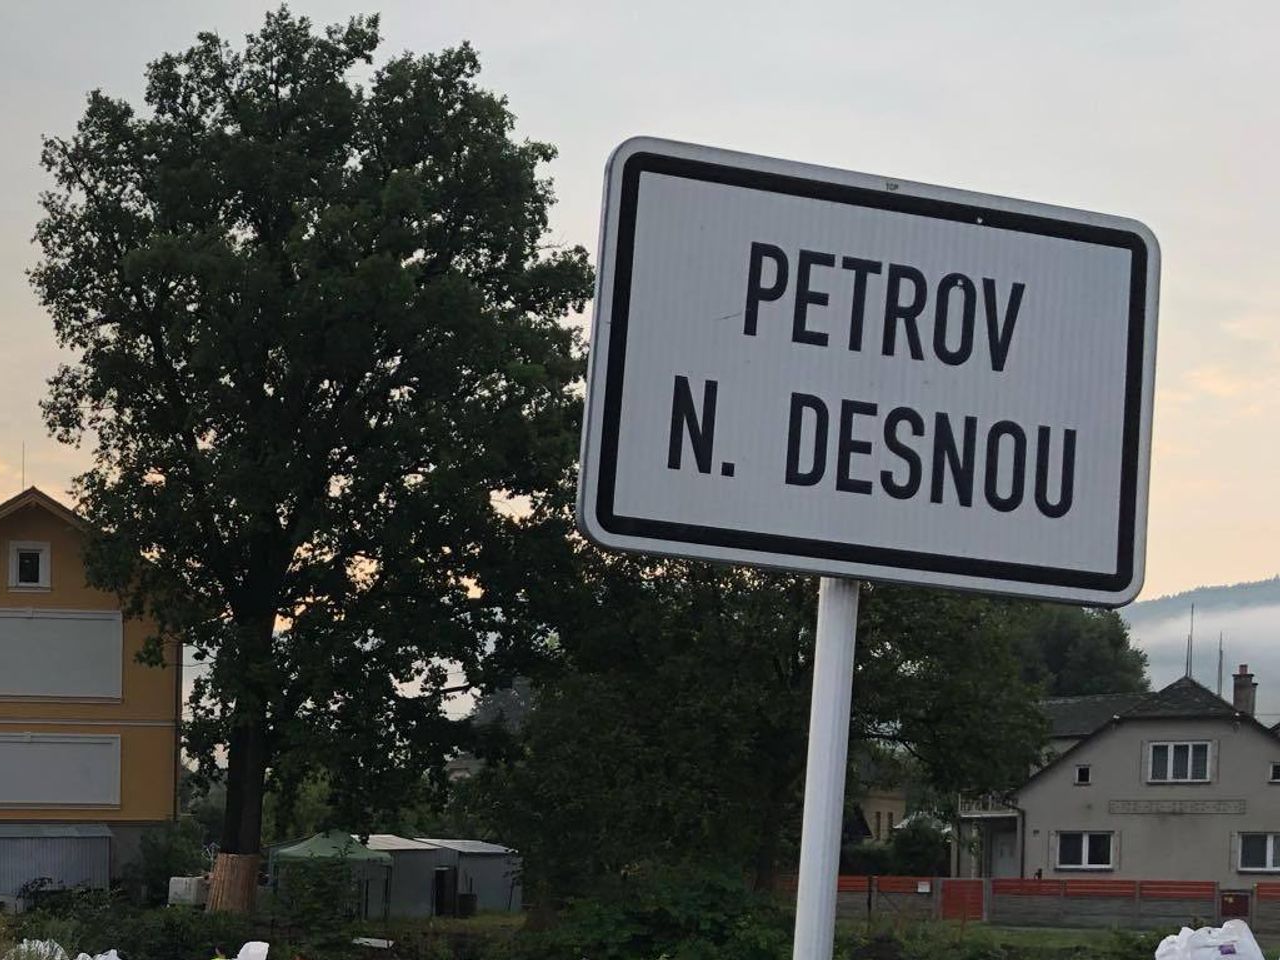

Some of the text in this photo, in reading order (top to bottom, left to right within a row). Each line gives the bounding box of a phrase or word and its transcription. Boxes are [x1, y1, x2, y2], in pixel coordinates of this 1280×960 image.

[742, 241, 1026, 372] PETROV
[667, 374, 1077, 519] N. DESNOU
